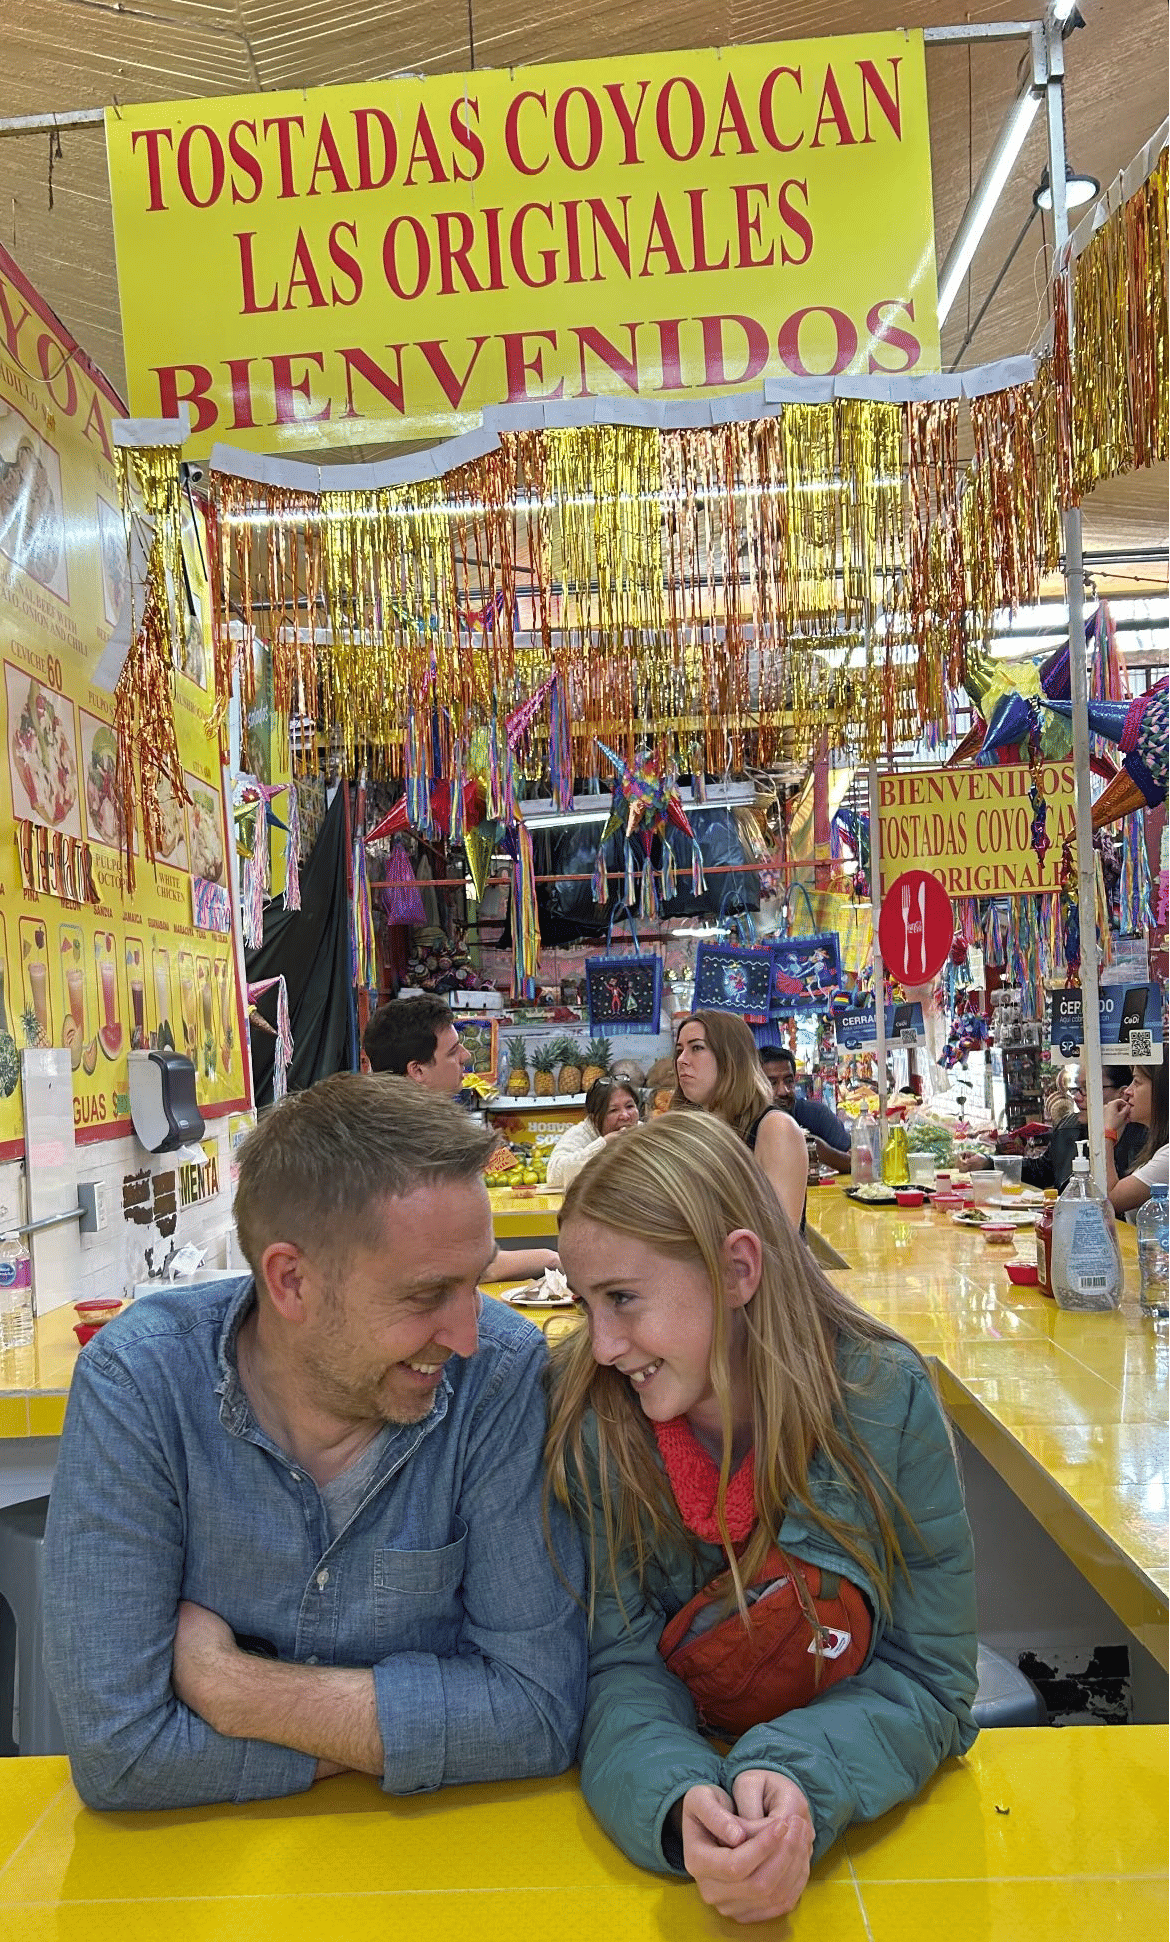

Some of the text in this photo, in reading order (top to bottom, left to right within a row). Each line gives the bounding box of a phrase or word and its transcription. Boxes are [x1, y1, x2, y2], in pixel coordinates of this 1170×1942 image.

[131, 56, 903, 212] TOSTADAS COYOACAN
[233, 177, 814, 315] LAS ORIGINALES
[148, 299, 921, 434] BIENVENIDOS
[11, 639, 46, 675] CEVICHE
[879, 766, 1075, 807] BIENVENIDOS
[878, 803, 1076, 860] TOSTADAS COYOCA
[158, 872, 181, 889] WHITE
[842, 1013, 888, 1027] CERRA
[1060, 998, 1114, 1015] CERDO
[180, 1156, 218, 1206] MENTA
